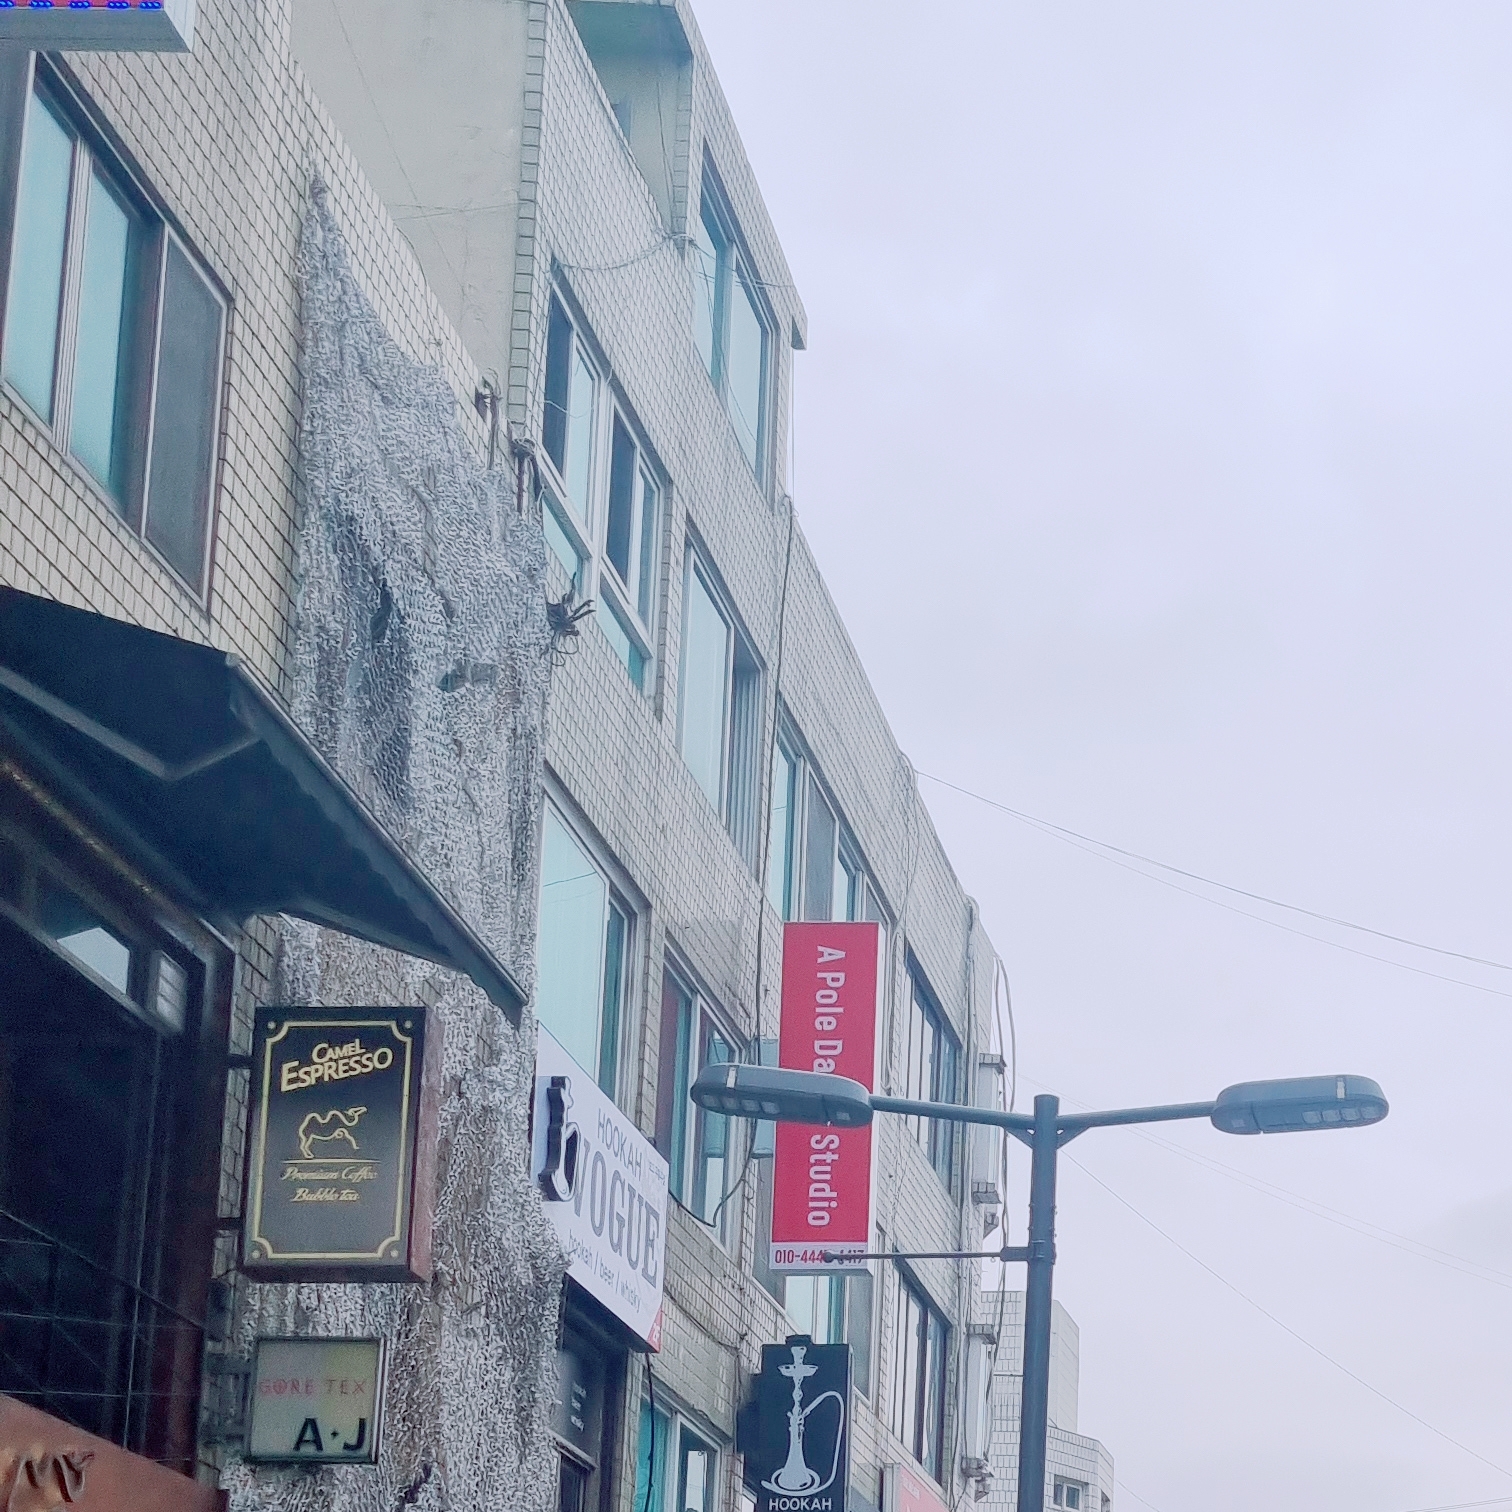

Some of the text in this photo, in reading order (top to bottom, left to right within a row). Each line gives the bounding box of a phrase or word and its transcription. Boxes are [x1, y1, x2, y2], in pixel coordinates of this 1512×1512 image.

[816, 945, 846, 964] A
[814, 971, 845, 1031] Pole
[281, 1047, 393, 1092] ESPRESSO
[312, 1038, 366, 1063] CAMEL
[597, 1107, 643, 1182] HOOKAH
[807, 1134, 840, 1227] Studio
[768, 1496, 832, 1512] HOOKAH
